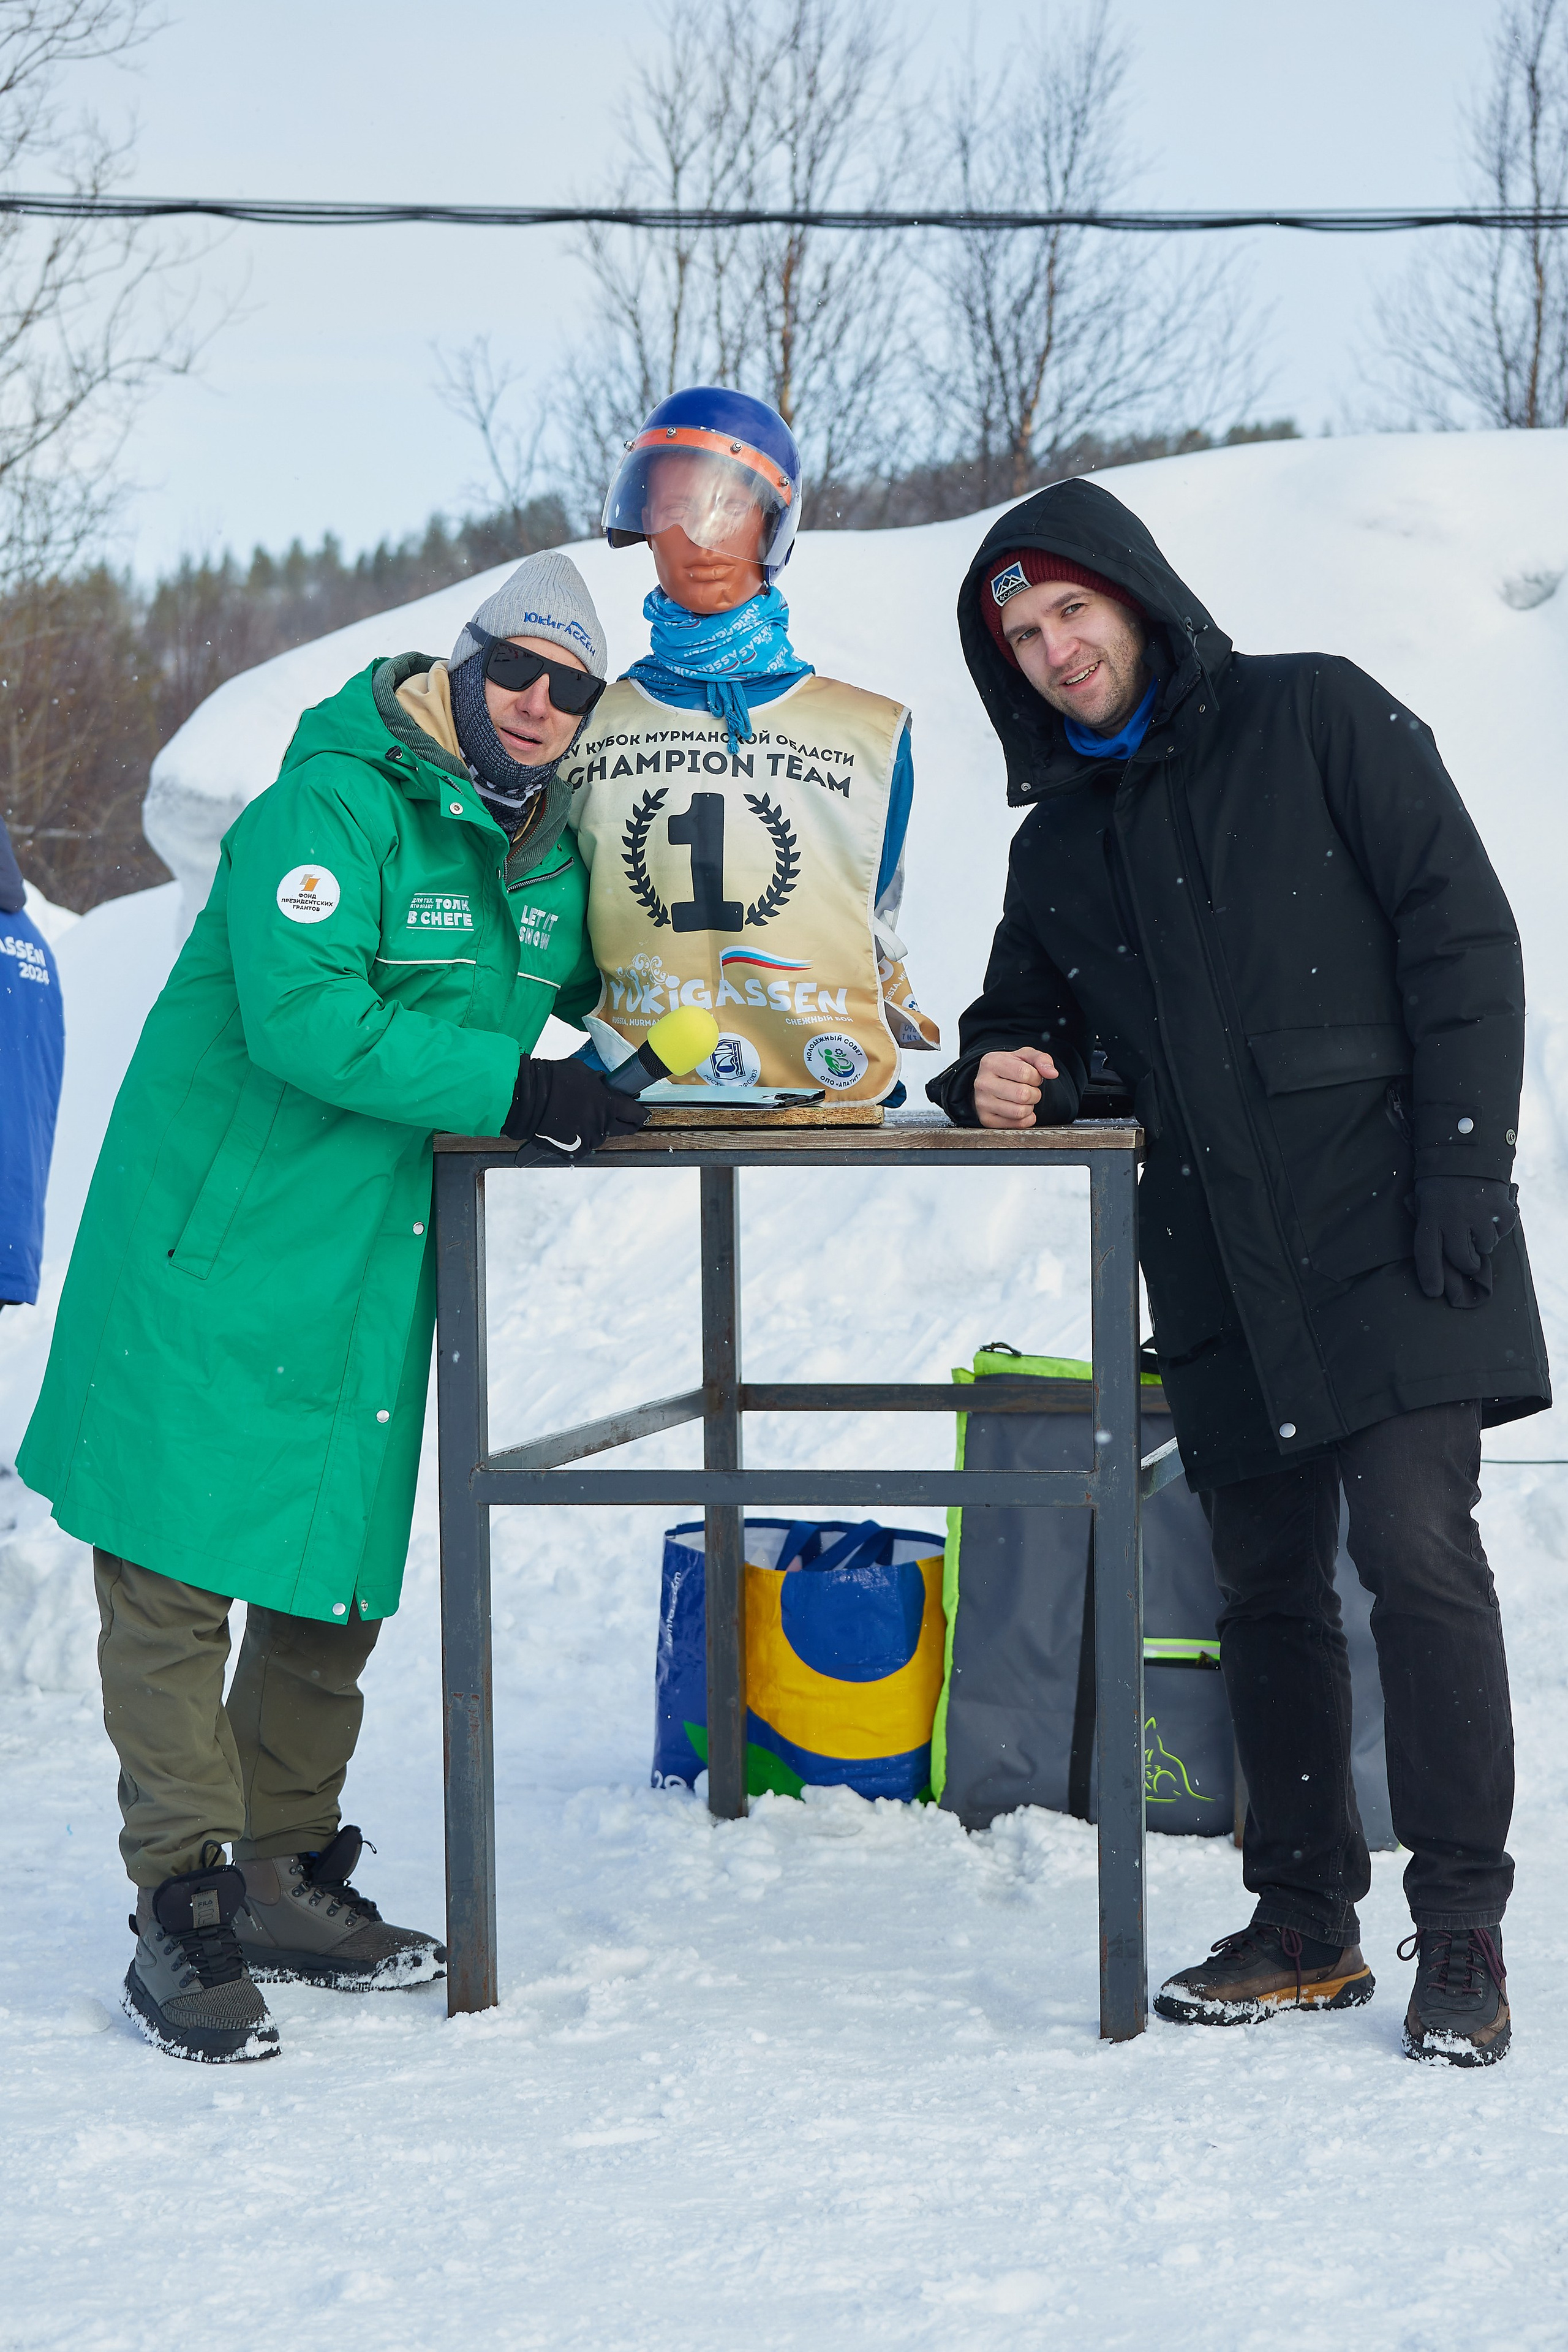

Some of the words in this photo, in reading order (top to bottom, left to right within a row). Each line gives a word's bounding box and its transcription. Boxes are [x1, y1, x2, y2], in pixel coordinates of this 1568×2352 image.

[1004, 584, 1026, 598] Columbia
[586, 734, 640, 755] КУБОК
[776, 735, 854, 767] ОБЛАСТИ
[567, 750, 754, 790] CHAMPION
[766, 753, 851, 799] TEAM
[668, 793, 744, 932] 1
[281, 898, 333, 907] ПРЕЗИДЕНТСКИХ
[435, 898, 470, 911] ТОЛК
[407, 911, 418, 924] В
[420, 911, 473, 926] СНЕГЕ
[521, 905, 546, 927] LET
[542, 913, 559, 932] IT
[519, 926, 551, 950] SNOW
[18, 962, 50, 986] 2024
[785, 1015, 834, 1025] СНЕЖНЫЙ
[807, 1035, 842, 1061] МОЛОДЕЖНЫЙ
[844, 1039, 863, 1057] СОВЕТ
[820, 1076, 835, 1085] ОПО
